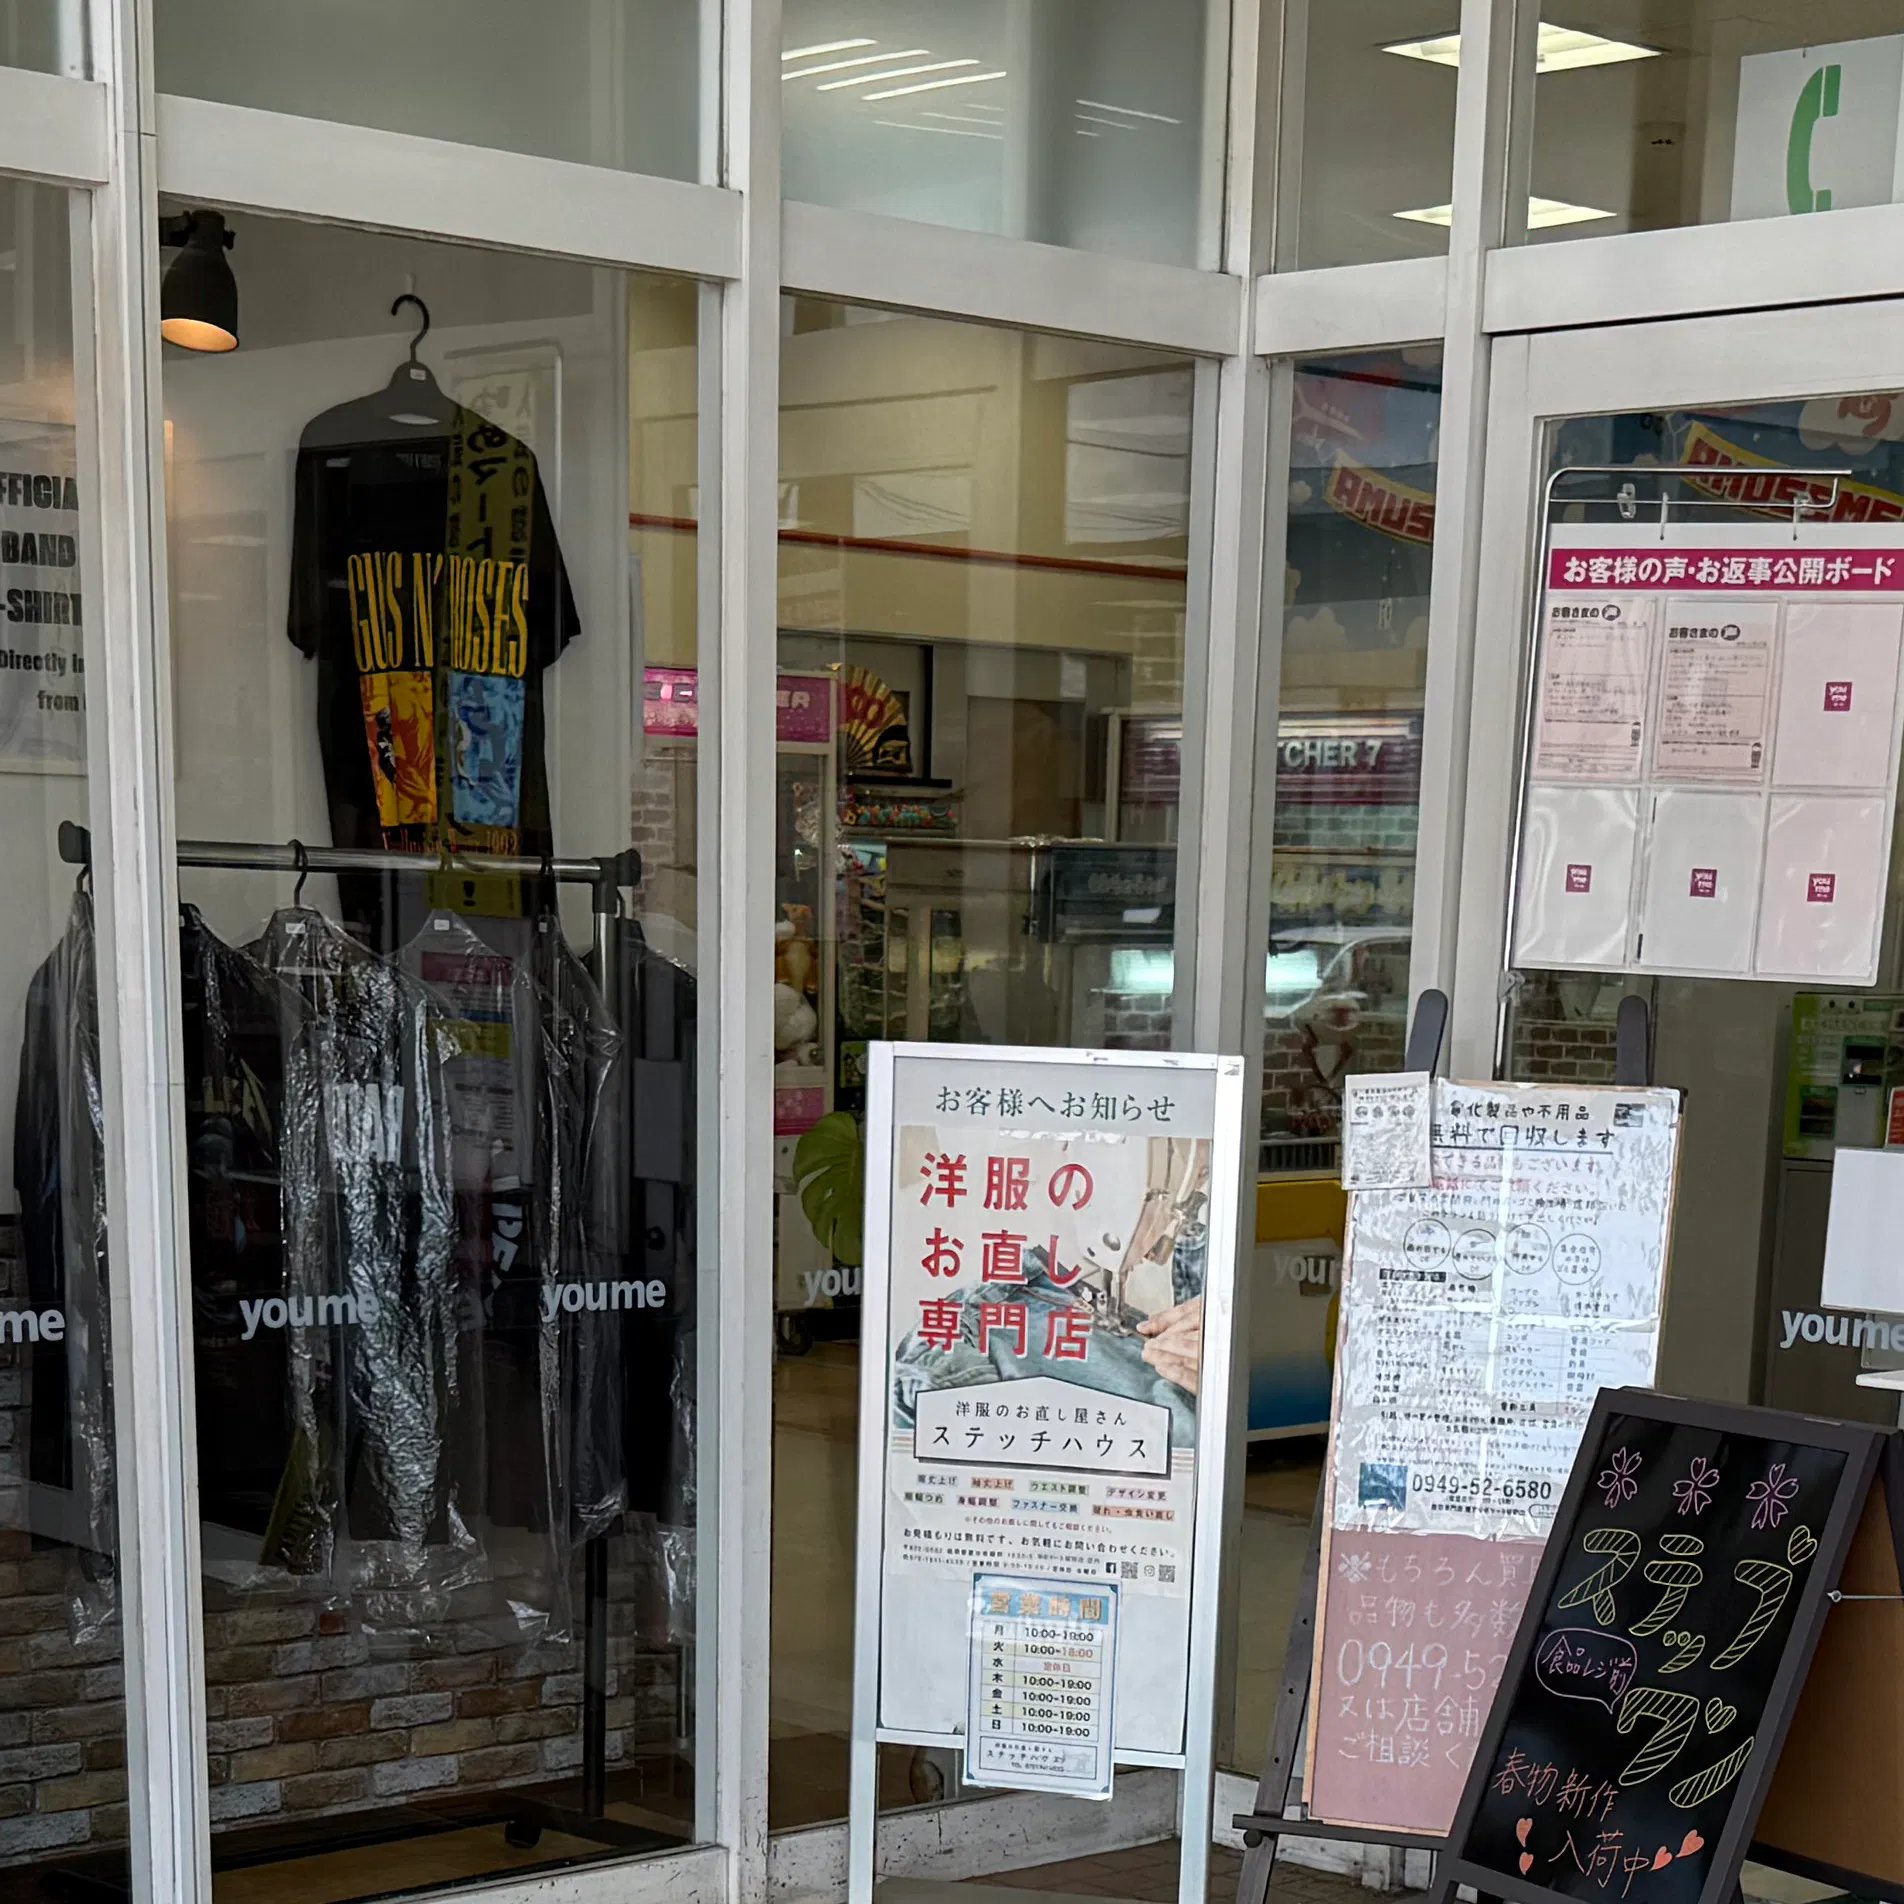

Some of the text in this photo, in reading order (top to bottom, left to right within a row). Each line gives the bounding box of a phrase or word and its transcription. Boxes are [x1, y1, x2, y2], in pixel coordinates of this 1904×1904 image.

[1, 530, 77, 568] BAND
[1562, 555, 1898, 586] お客様の声・お返事公開ボード
[37, 690, 80, 713] from
[935, 1085, 1176, 1123] お客様へお知らせ
[918, 1151, 1095, 1213] 洋服の
[919, 1226, 1084, 1288] お直し
[238, 1288, 381, 1342] youme
[542, 1276, 668, 1324] youme
[917, 1297, 1095, 1362] 専門店
[955, 1399, 1128, 1427] 洋服のお直し屋さん
[932, 1424, 1148, 1459] ステッチハウス
[1411, 1474, 1552, 1500] 0949-52-6580
[1492, 1746, 1620, 1823] 春物新作
[1554, 1828, 1651, 1900] 入荷中
